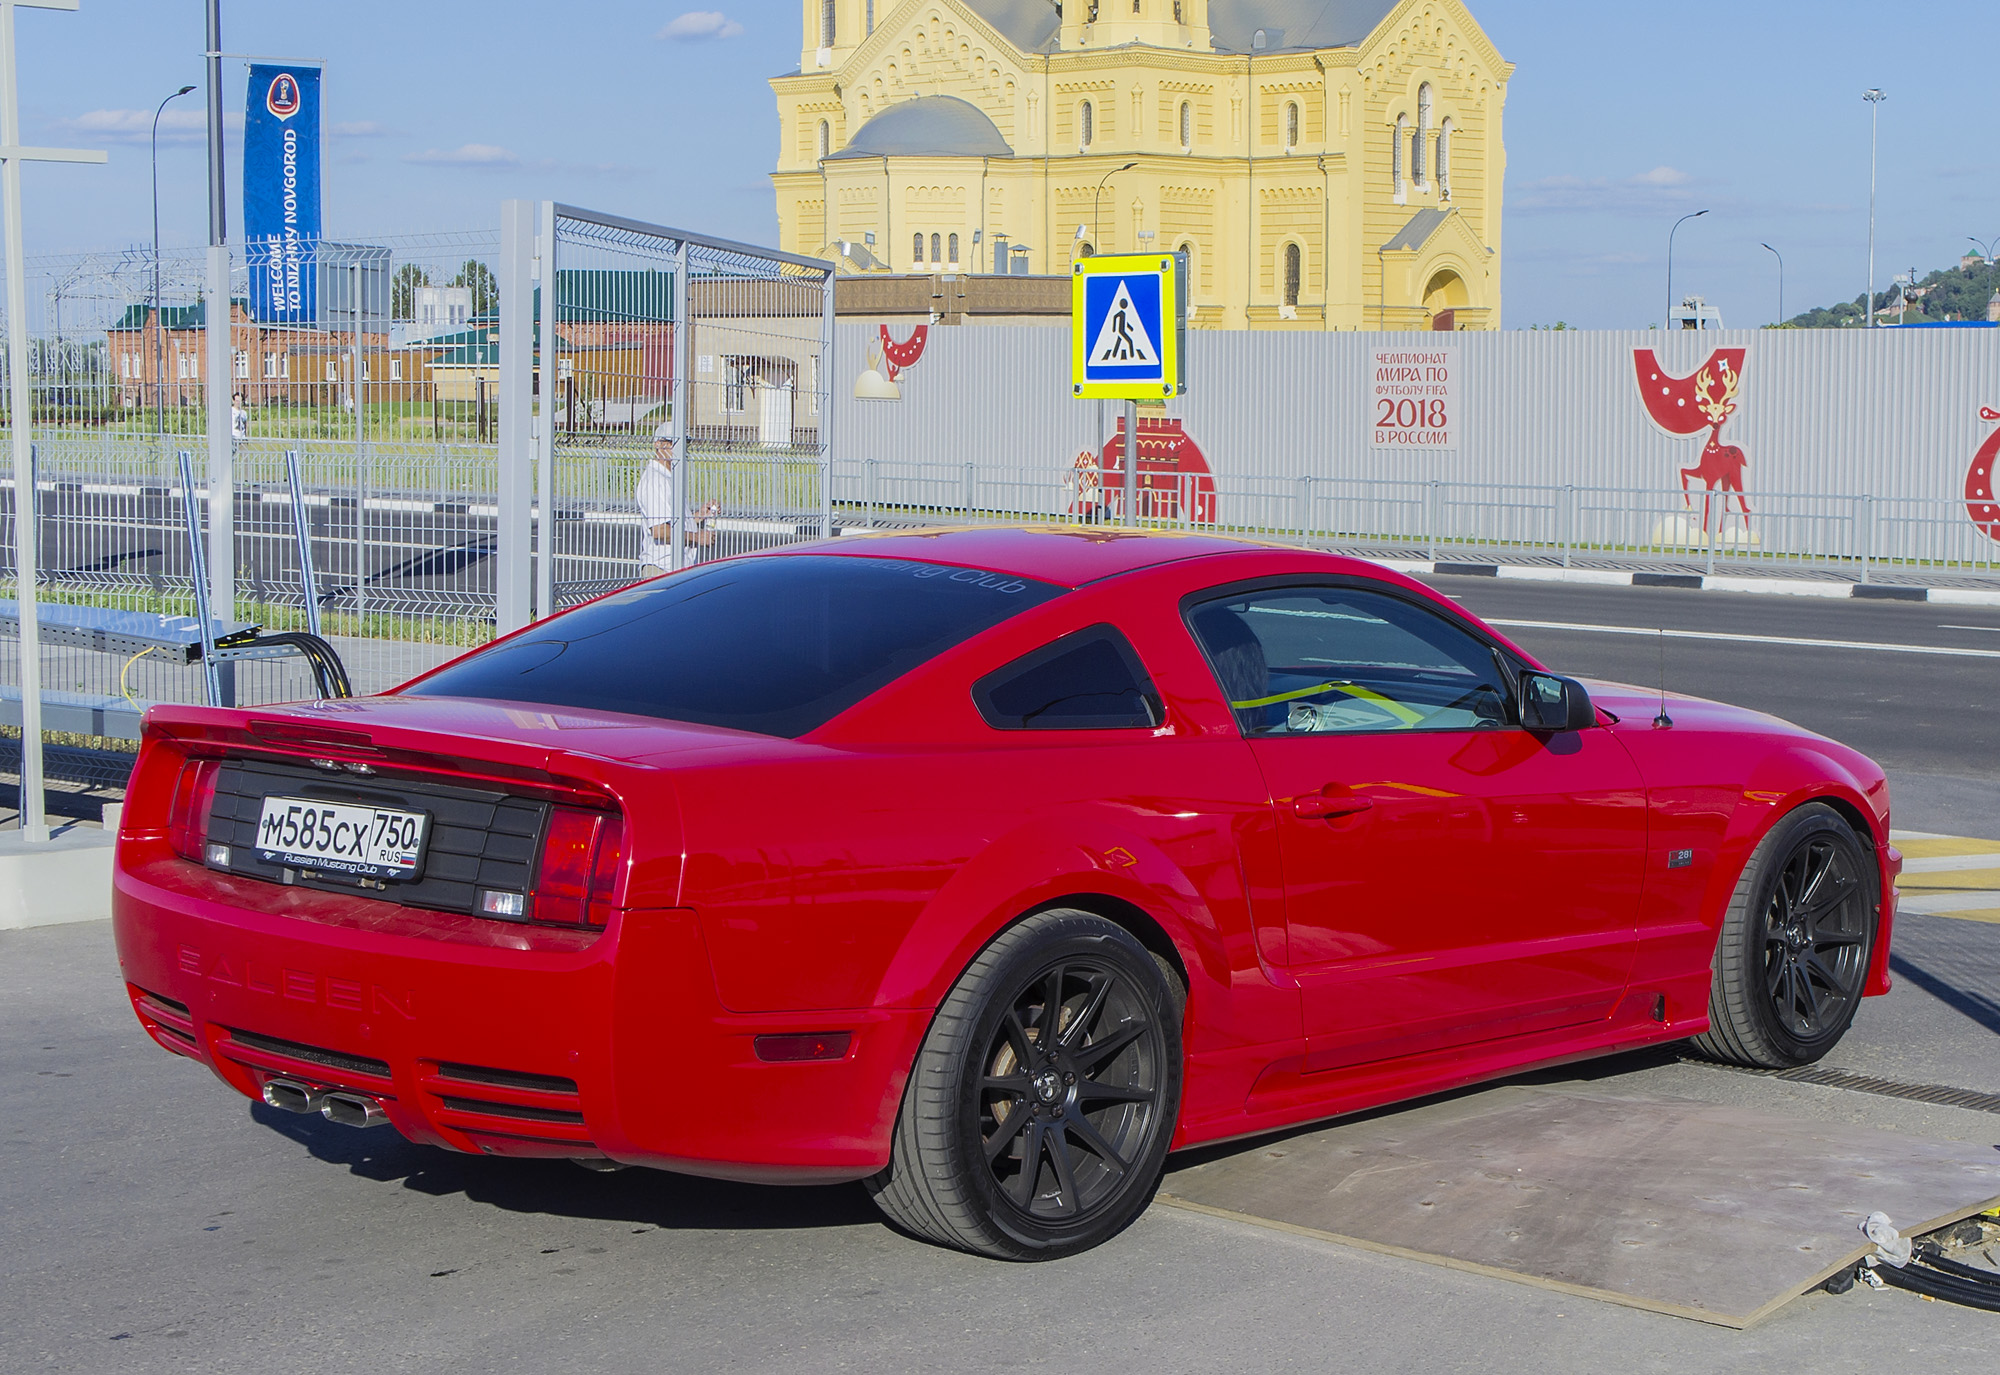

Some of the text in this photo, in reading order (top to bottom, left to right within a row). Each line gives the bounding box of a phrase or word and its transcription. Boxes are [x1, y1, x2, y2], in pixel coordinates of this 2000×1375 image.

[284, 129, 301, 312] TO NIZHNY NOVGOROD
[267, 233, 286, 311] WELCOME
[1376, 353, 1448, 364] ЧЕМПИОНАТ
[1376, 367, 1448, 382] МИРА ПО
[1375, 385, 1448, 395] ФУТБОЛУ FIFA
[1376, 398, 1447, 428] 2018
[1375, 430, 1447, 444] В РОССИИ
[949, 568, 1027, 594] Club
[373, 814, 416, 850] 750
[284, 852, 378, 874] Russian Mustang Club
[379, 850, 401, 863] RUS
